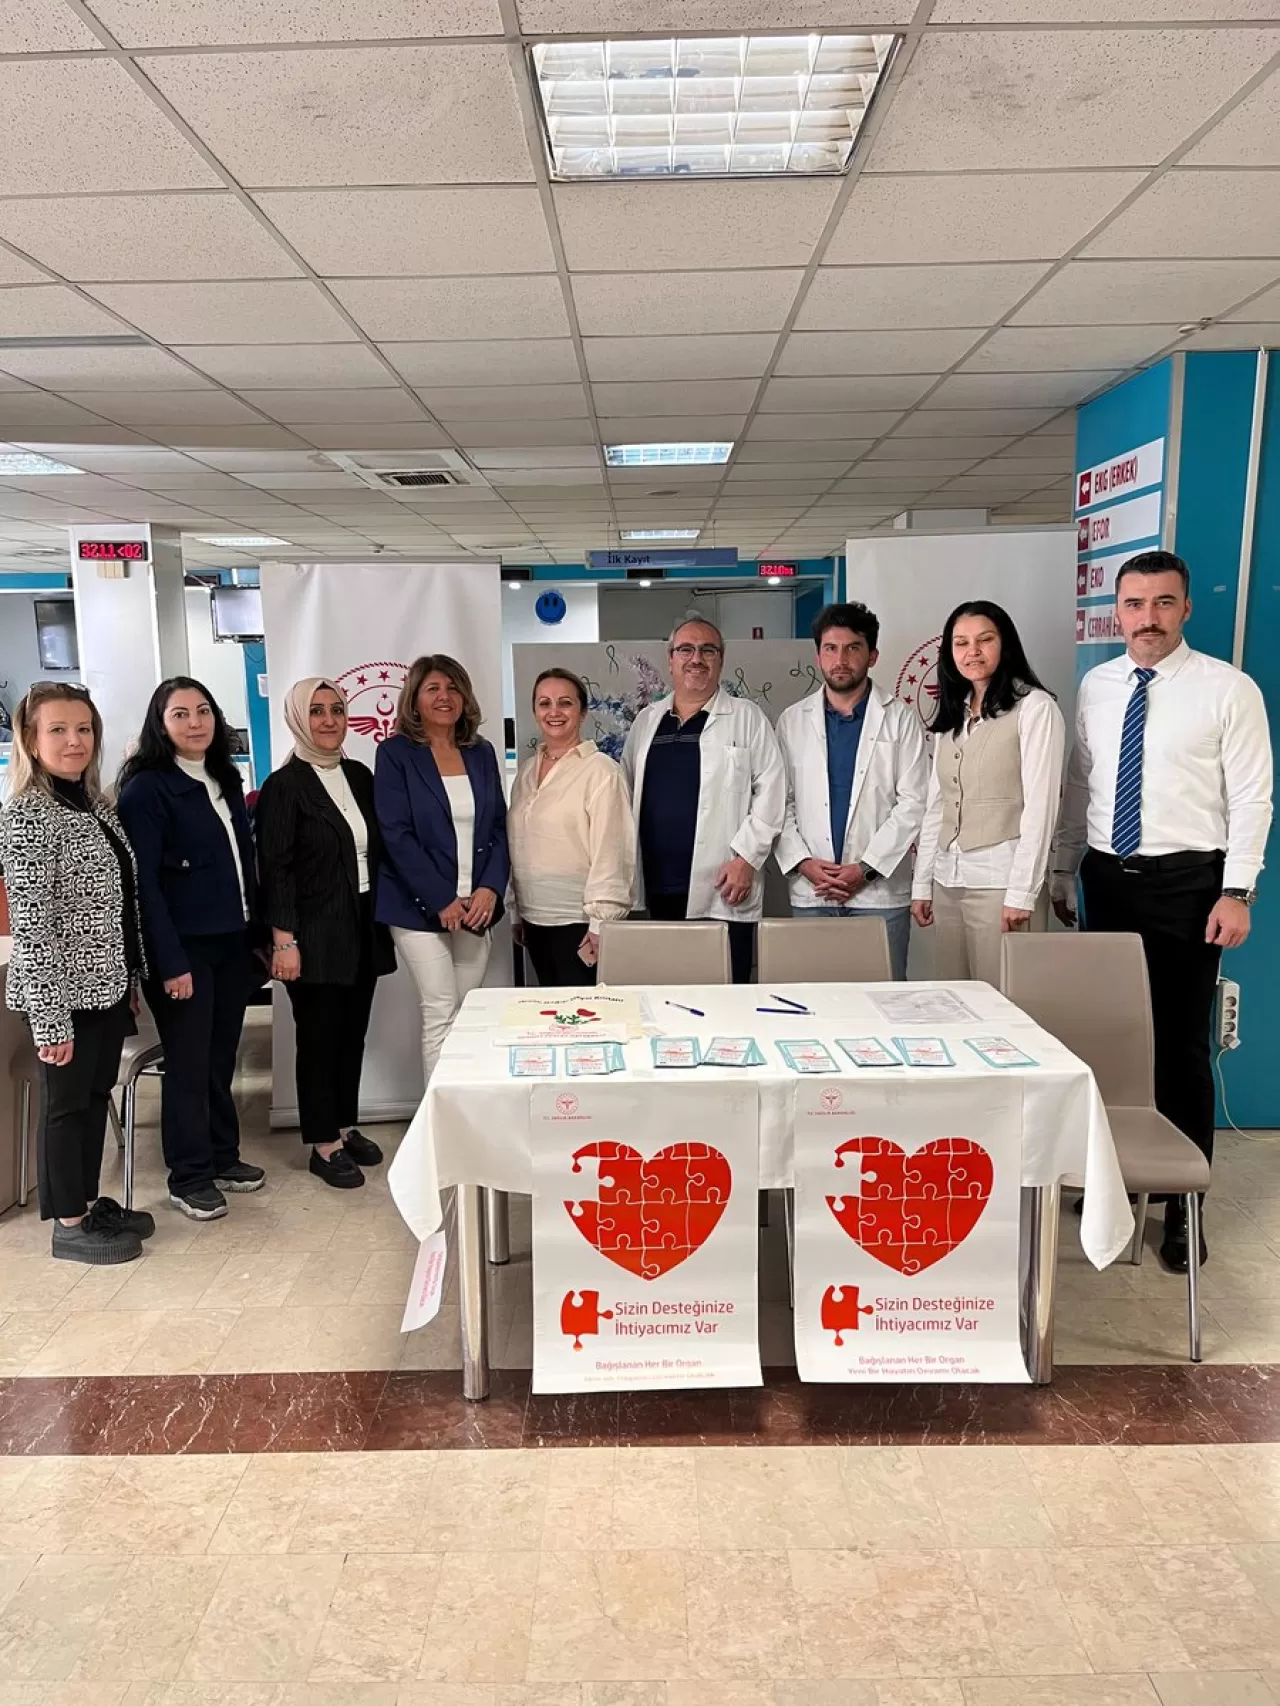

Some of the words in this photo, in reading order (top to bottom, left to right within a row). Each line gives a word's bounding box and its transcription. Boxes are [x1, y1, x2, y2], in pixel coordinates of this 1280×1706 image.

[1094, 468, 1109, 494] EKG
[1110, 456, 1138, 492] (ERKEK)
[1092, 517, 1110, 542] EFOR
[607, 552, 622, 565] İlk
[624, 555, 651, 566] Kayıt
[1091, 566, 1105, 589] EKO
[615, 1301, 648, 1316] Sizin
[652, 1300, 734, 1317] Desteğinize
[875, 1297, 909, 1312] Sizin
[912, 1296, 995, 1313] Desteğinize
[615, 1319, 691, 1338] İhtiyacımız
[695, 1320, 719, 1334] Var
[875, 1315, 952, 1333] İhtiyacımız
[955, 1317, 979, 1331] Var
[645, 1360, 660, 1369] Her
[662, 1359, 674, 1368] Bir
[908, 1355, 923, 1364] Her
[925, 1355, 937, 1364] Bir
[938, 1354, 965, 1365] Organ
